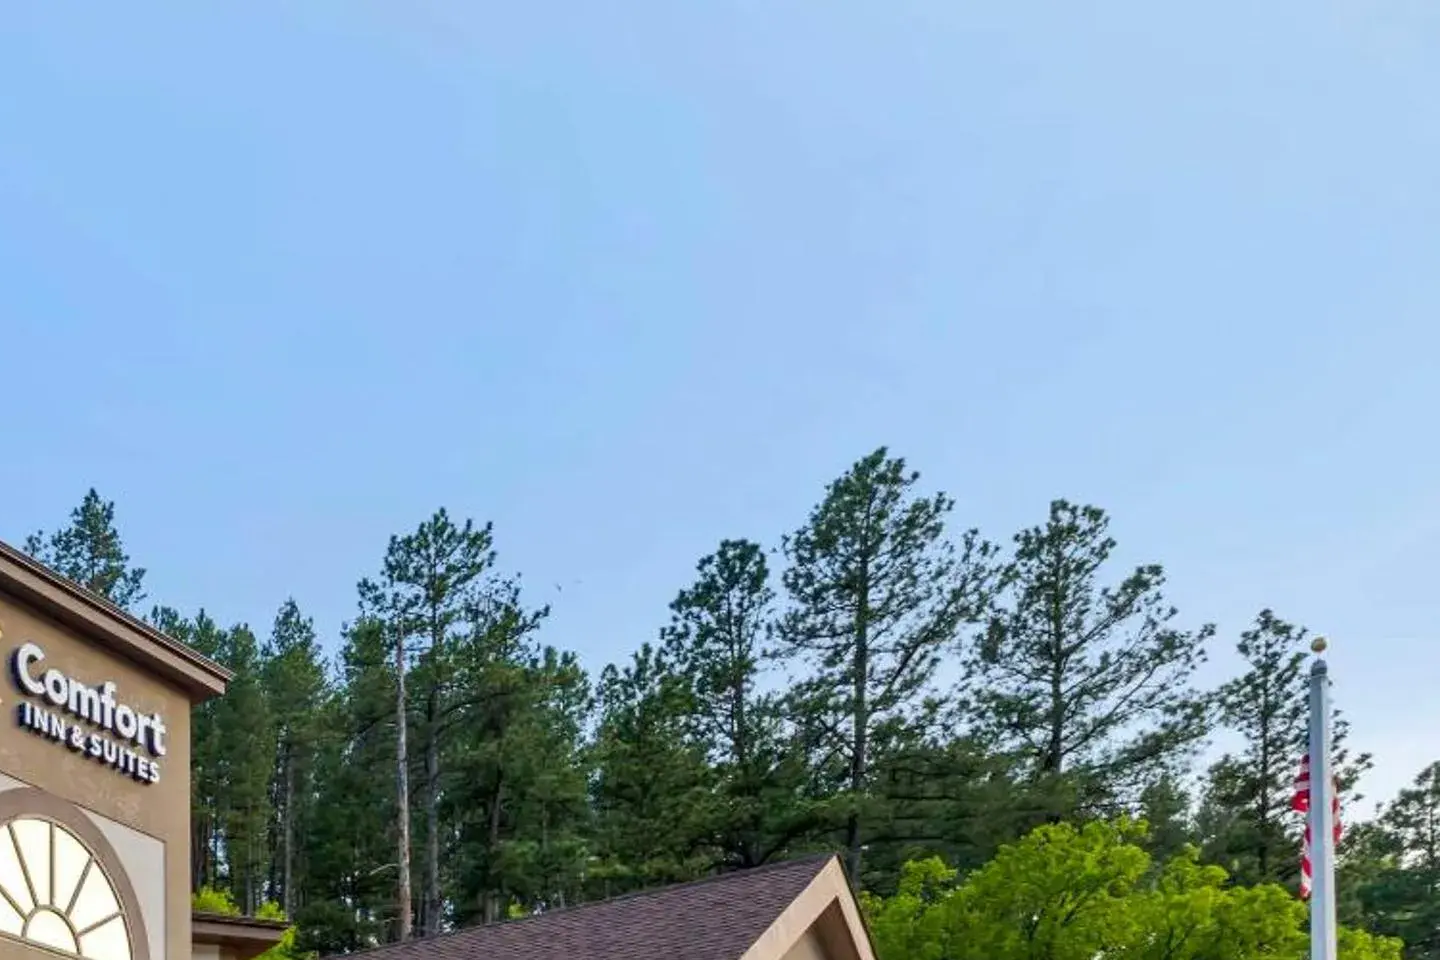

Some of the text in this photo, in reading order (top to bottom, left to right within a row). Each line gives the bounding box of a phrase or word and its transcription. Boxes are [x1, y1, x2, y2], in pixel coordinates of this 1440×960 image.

[13, 642, 167, 756] Comfort
[21, 701, 160, 784] INN & SUITES
